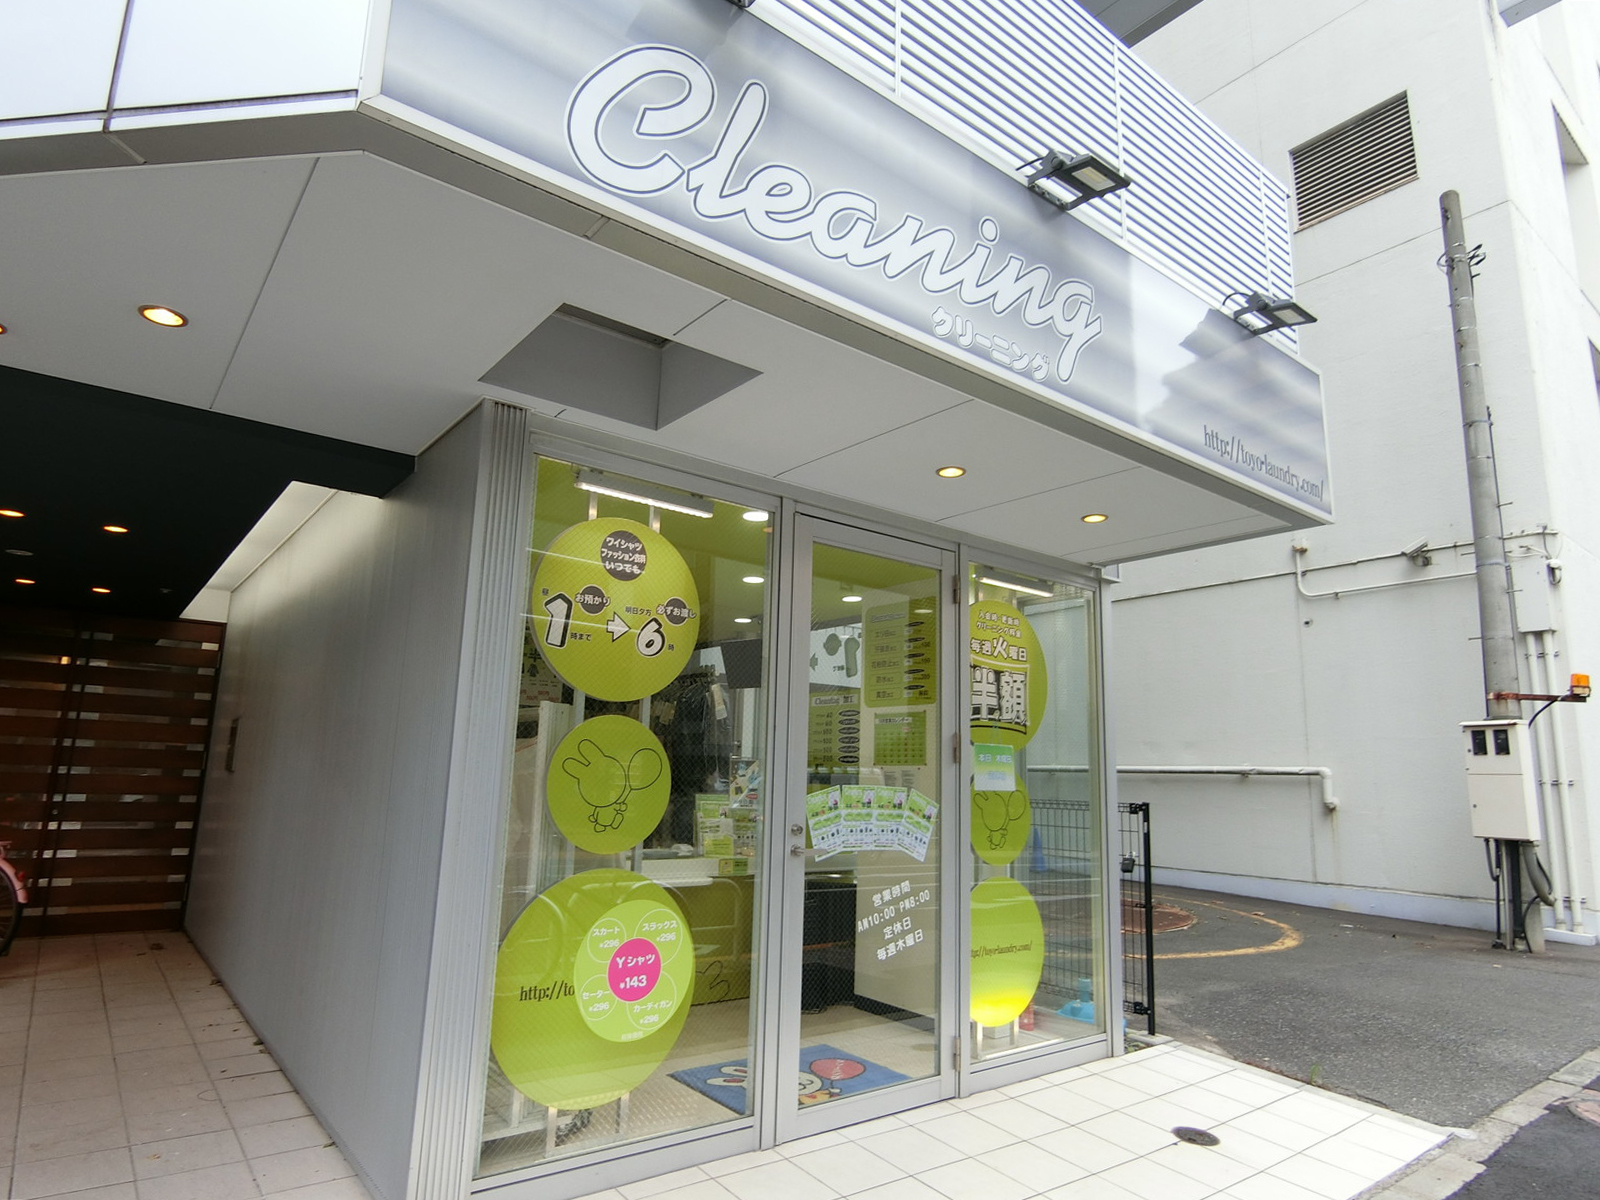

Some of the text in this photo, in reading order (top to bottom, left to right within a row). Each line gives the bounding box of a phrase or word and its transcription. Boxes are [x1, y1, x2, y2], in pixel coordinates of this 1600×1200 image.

[566, 44, 1103, 384] Cleaning
[931, 305, 1051, 383] クリーニング
[606, 536, 643, 551] ワイシャツ
[605, 560, 641, 574] いつでも
[575, 592, 611, 607] お預かり
[625, 606, 652, 616] 明日夕方
[656, 604, 697, 619] 必ずお渡し
[544, 592, 592, 648] 1 時まで
[636, 616, 666, 657] 6
[970, 635, 1028, 663] 毎週火曜日
[971, 665, 1027, 725] 半額
[872, 880, 911, 907] 営業時間
[592, 926, 620, 936] スカート
[642, 920, 677, 932] スラックス
[857, 905, 896, 933] AM10:00
[883, 916, 912, 940] 定休日
[876, 928, 924, 960] 毎週木曜日
[616, 954, 656, 969] Yシャツ
[582, 988, 611, 1000] セーター
